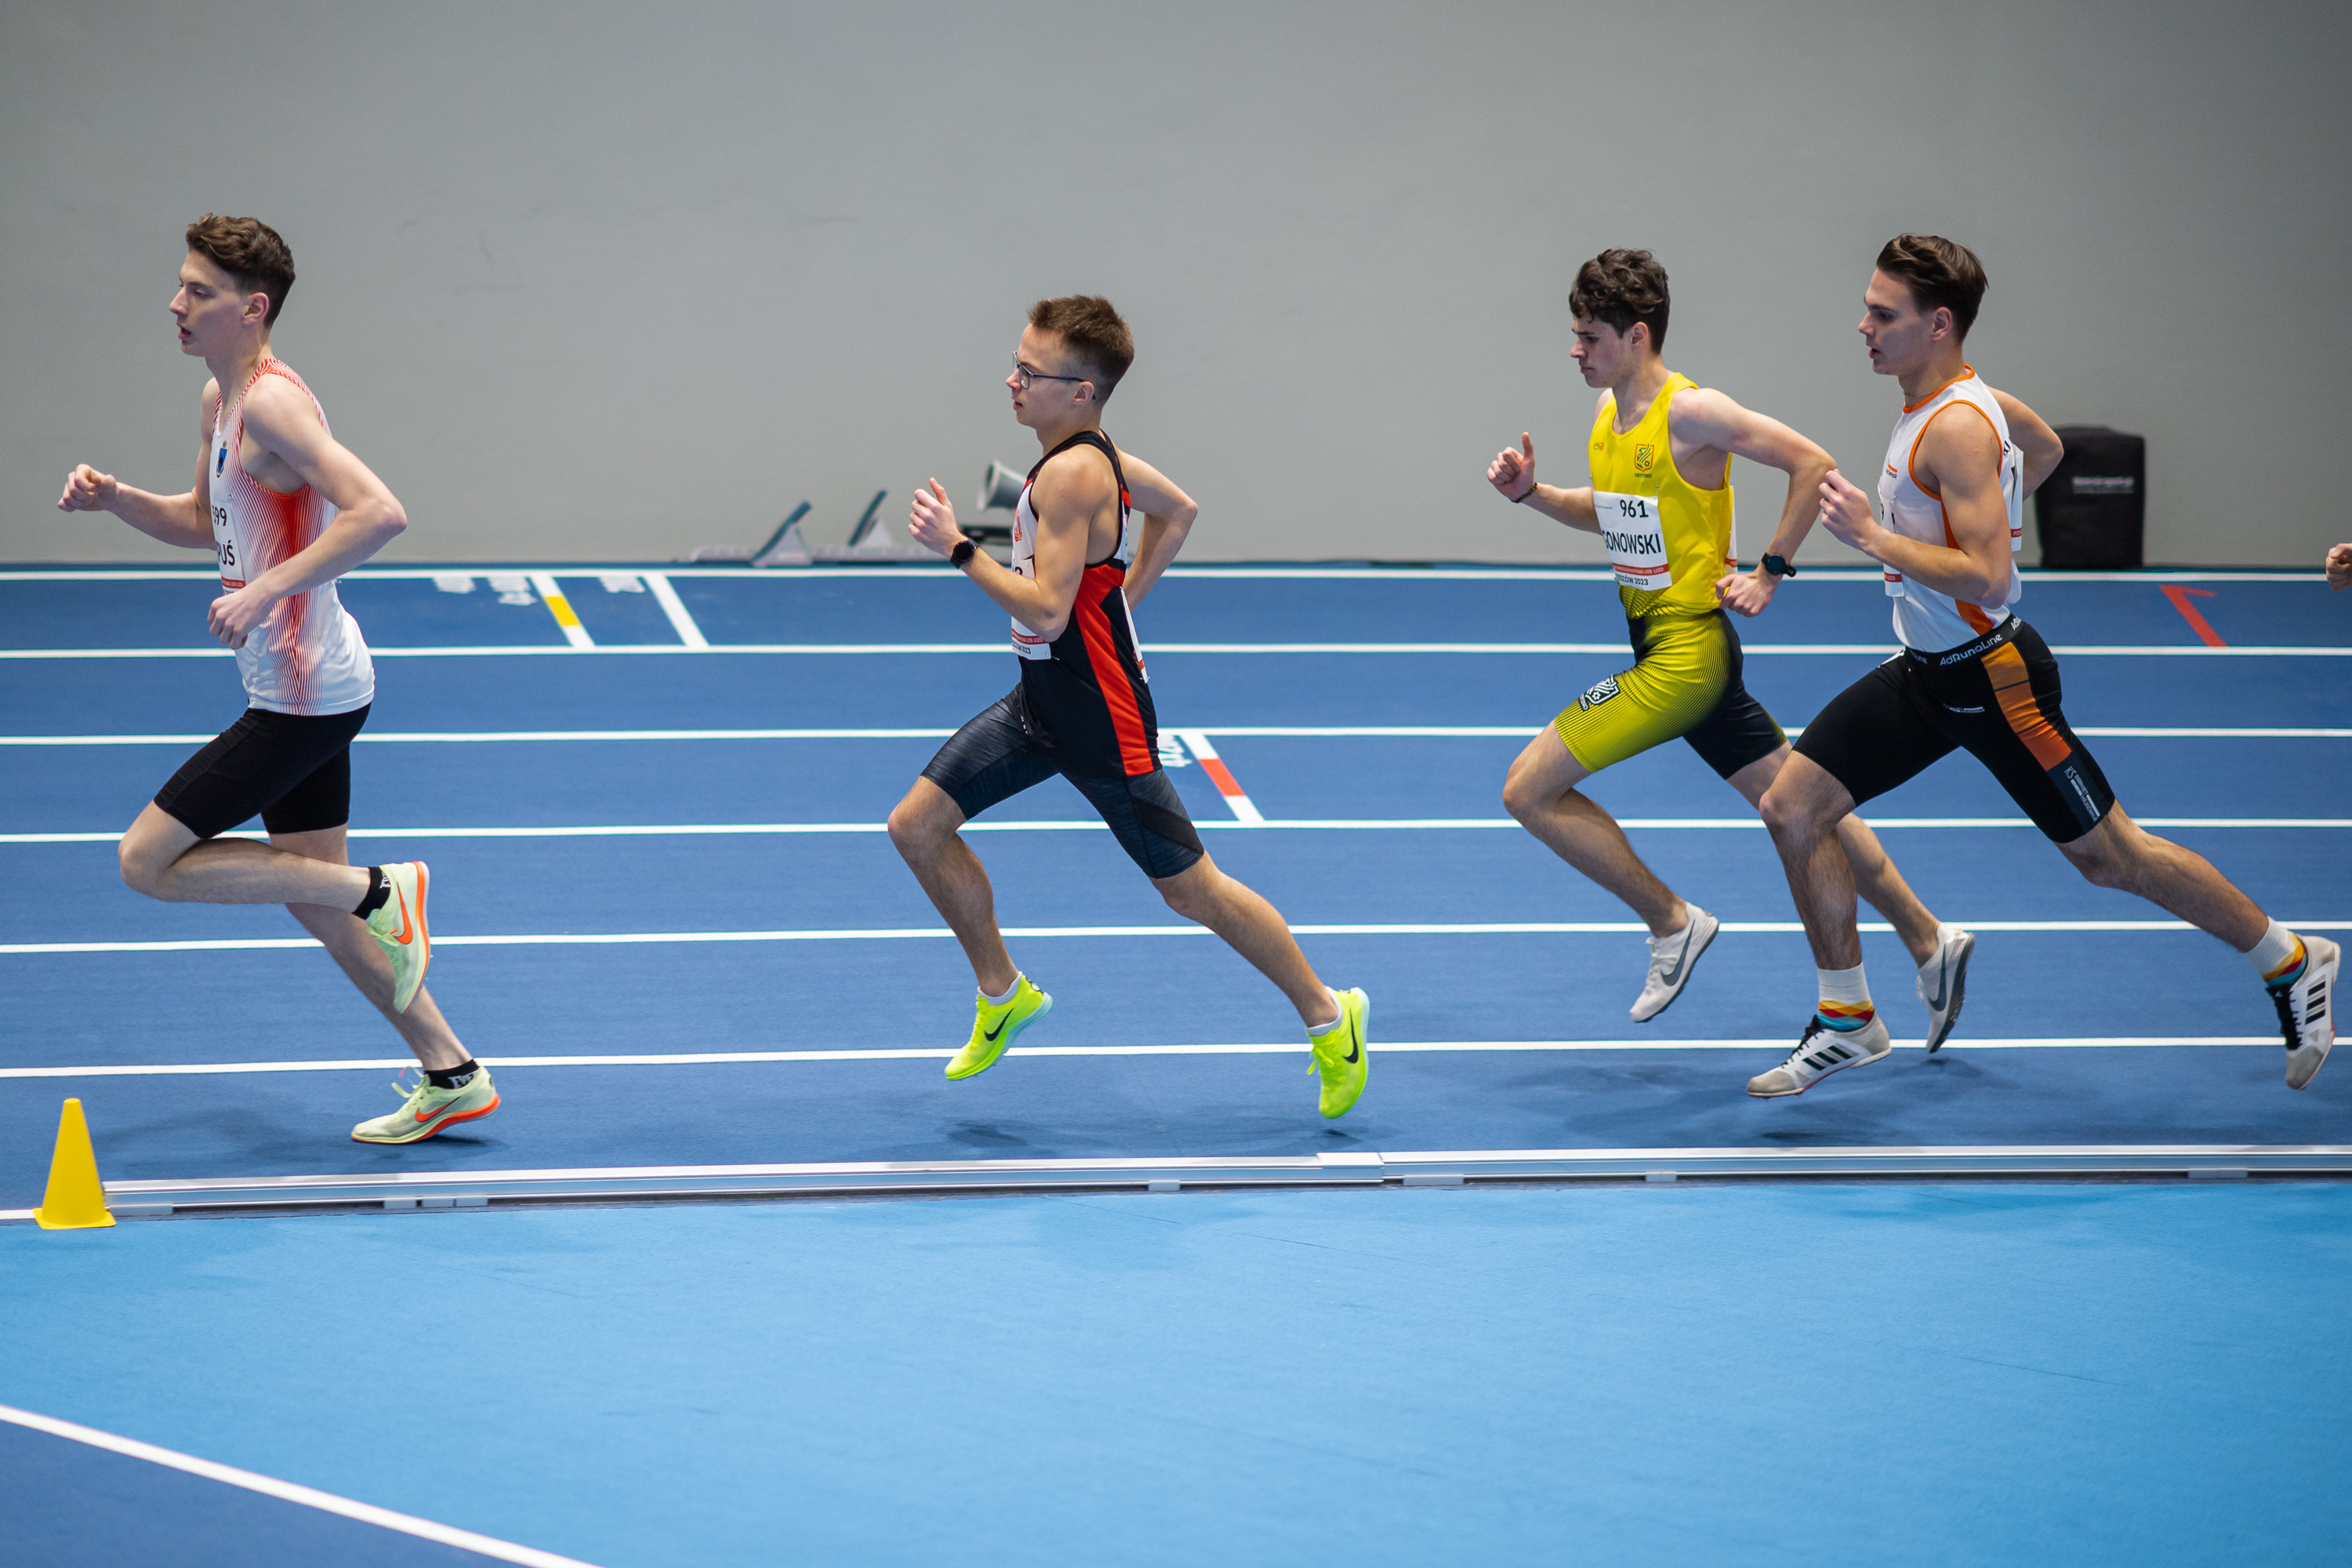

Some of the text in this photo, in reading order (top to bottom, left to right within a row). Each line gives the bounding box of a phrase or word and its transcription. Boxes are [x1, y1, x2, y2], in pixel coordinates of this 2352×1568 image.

[1620, 499, 1649, 518] 961
[1634, 577, 1649, 586] 2023
[1940, 633, 2002, 666] AdRunaLine
[2063, 765, 2077, 779] KS
